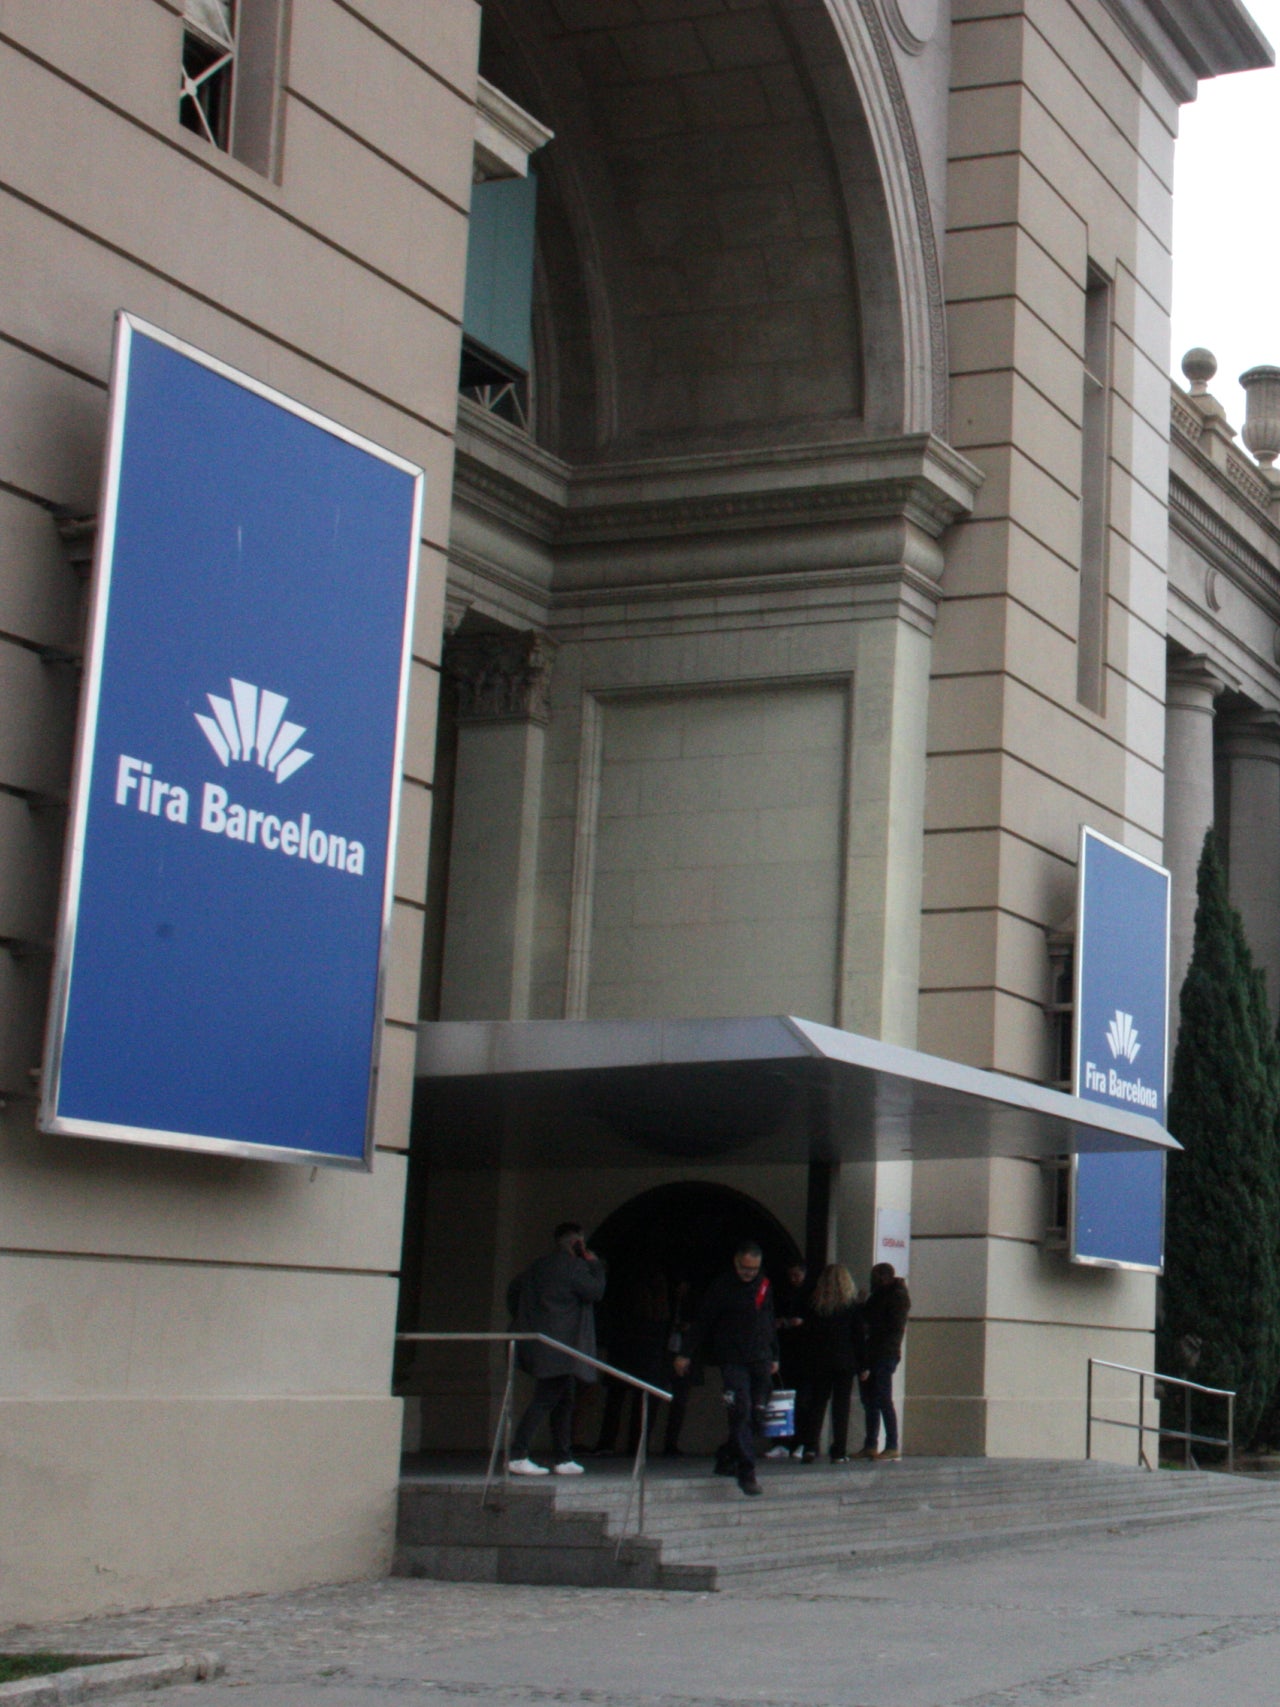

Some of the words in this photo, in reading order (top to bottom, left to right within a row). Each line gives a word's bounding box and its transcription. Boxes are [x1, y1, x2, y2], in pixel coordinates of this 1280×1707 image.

[115, 754, 189, 824] Fira
[200, 782, 365, 876] Barcelona
[1086, 1061, 1106, 1093] Fira
[1109, 1068, 1157, 1109] Barcelona
